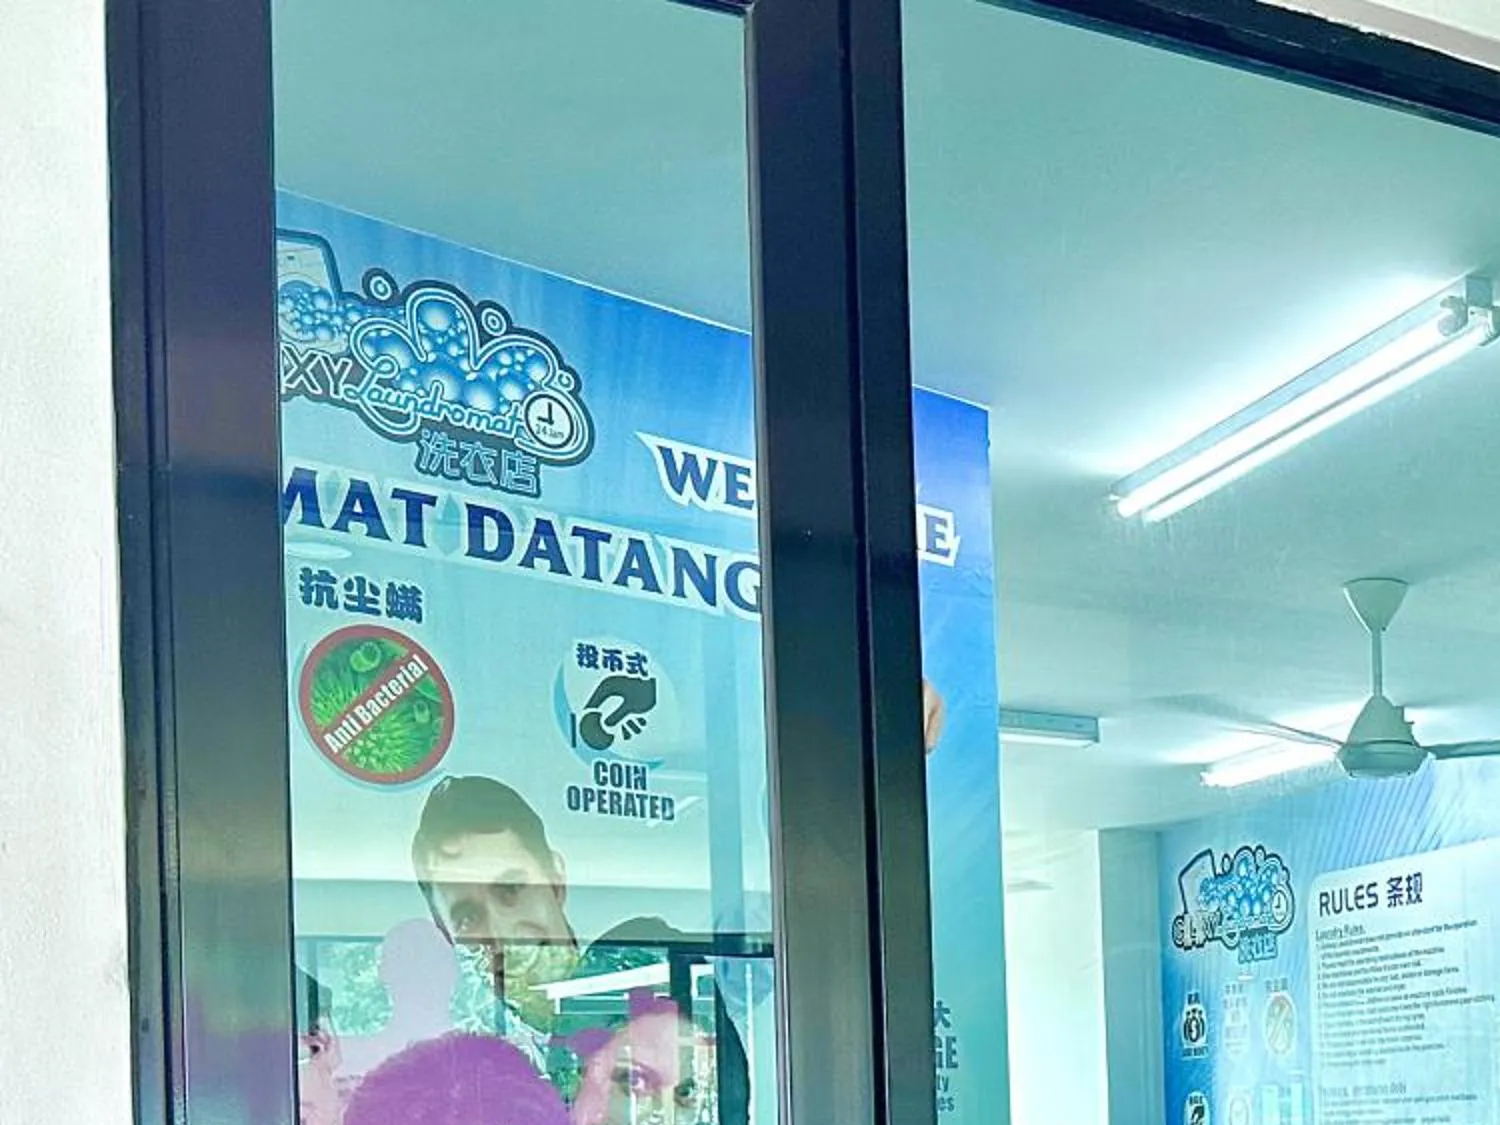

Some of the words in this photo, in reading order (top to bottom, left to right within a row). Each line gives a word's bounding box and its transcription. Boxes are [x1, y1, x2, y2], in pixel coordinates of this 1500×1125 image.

[342, 360, 524, 437] Laundromat
[419, 430, 538, 493] 洗衣店
[464, 502, 761, 613] DATANG
[576, 642, 649, 677] 投币式
[323, 717, 360, 754] Anti
[356, 654, 430, 732] Bacterial
[593, 761, 647, 791] COIN
[566, 786, 675, 821] OPERATED
[1319, 882, 1379, 917] RULES
